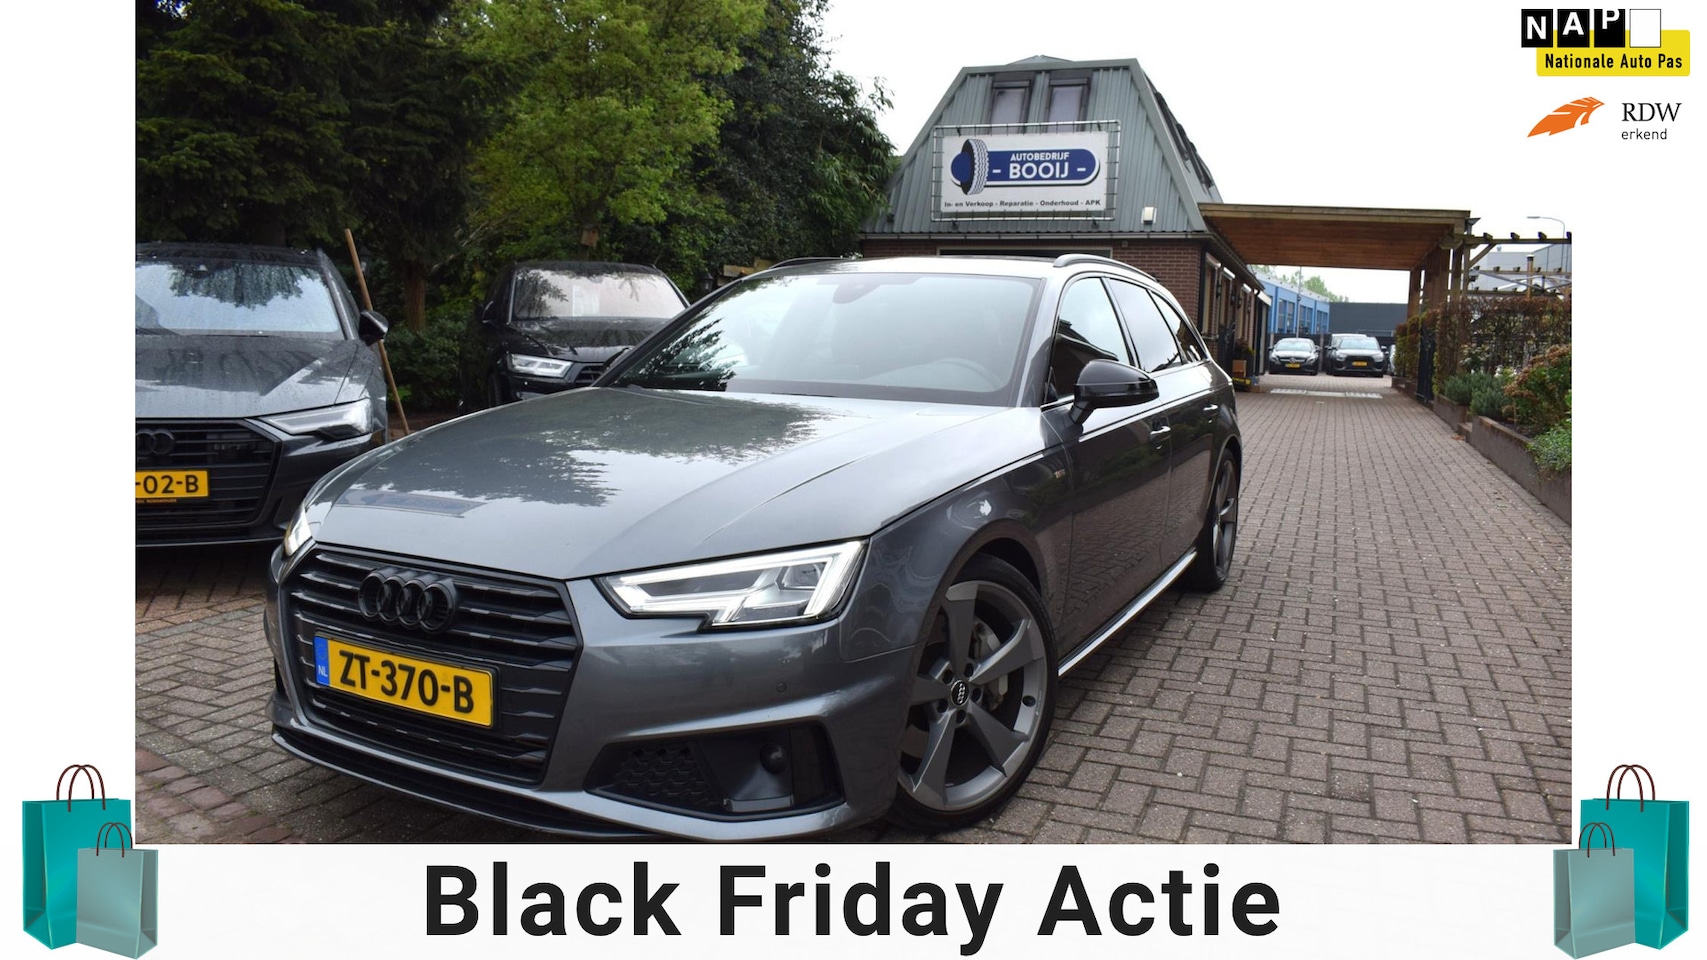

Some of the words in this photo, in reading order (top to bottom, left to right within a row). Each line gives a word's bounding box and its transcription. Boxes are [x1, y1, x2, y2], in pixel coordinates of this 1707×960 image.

[1010, 151, 1070, 162] AUTOBEDRIJF
[1009, 163, 1069, 179] BOOIJ
[965, 200, 994, 208] Verkoop
[999, 200, 1034, 208] Reparatie
[1039, 199, 1079, 207] Onderhoud
[318, 664, 328, 677] NL
[339, 650, 475, 714] ZT-370-B
